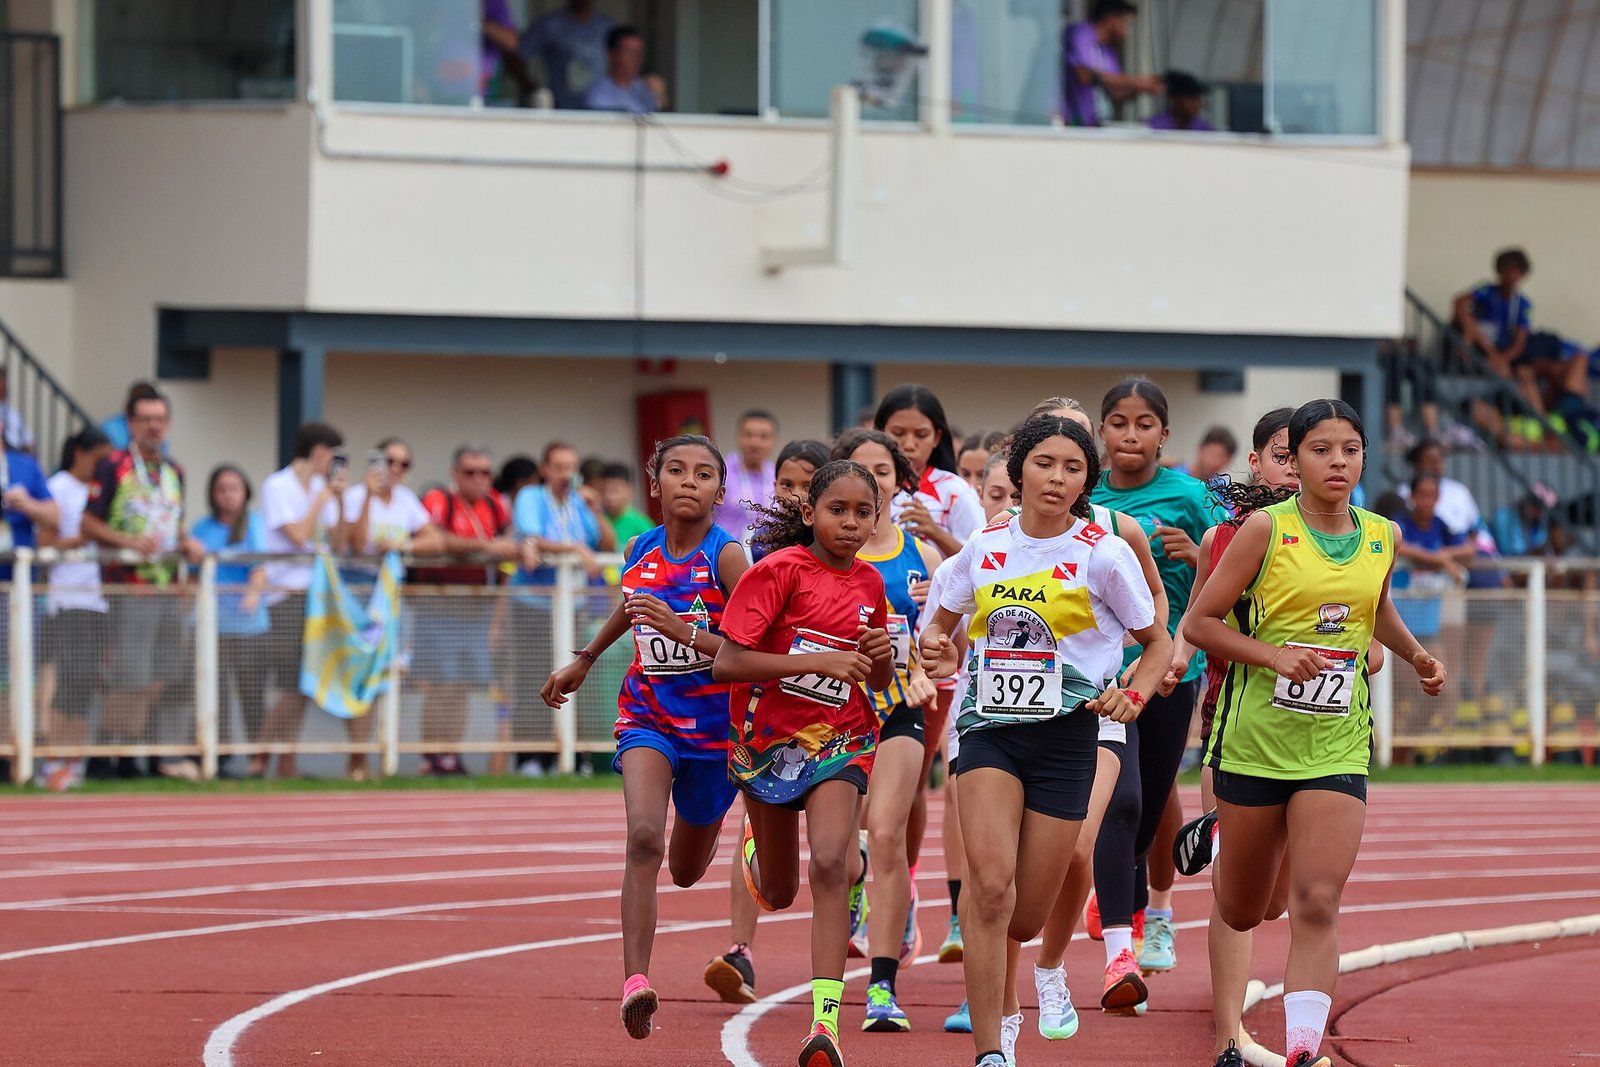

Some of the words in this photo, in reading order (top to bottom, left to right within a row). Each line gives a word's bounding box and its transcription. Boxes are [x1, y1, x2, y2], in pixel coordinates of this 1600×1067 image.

[991, 584, 1047, 603] PARÁ
[1005, 609, 1016, 617] DE
[991, 673, 1045, 706] 392
